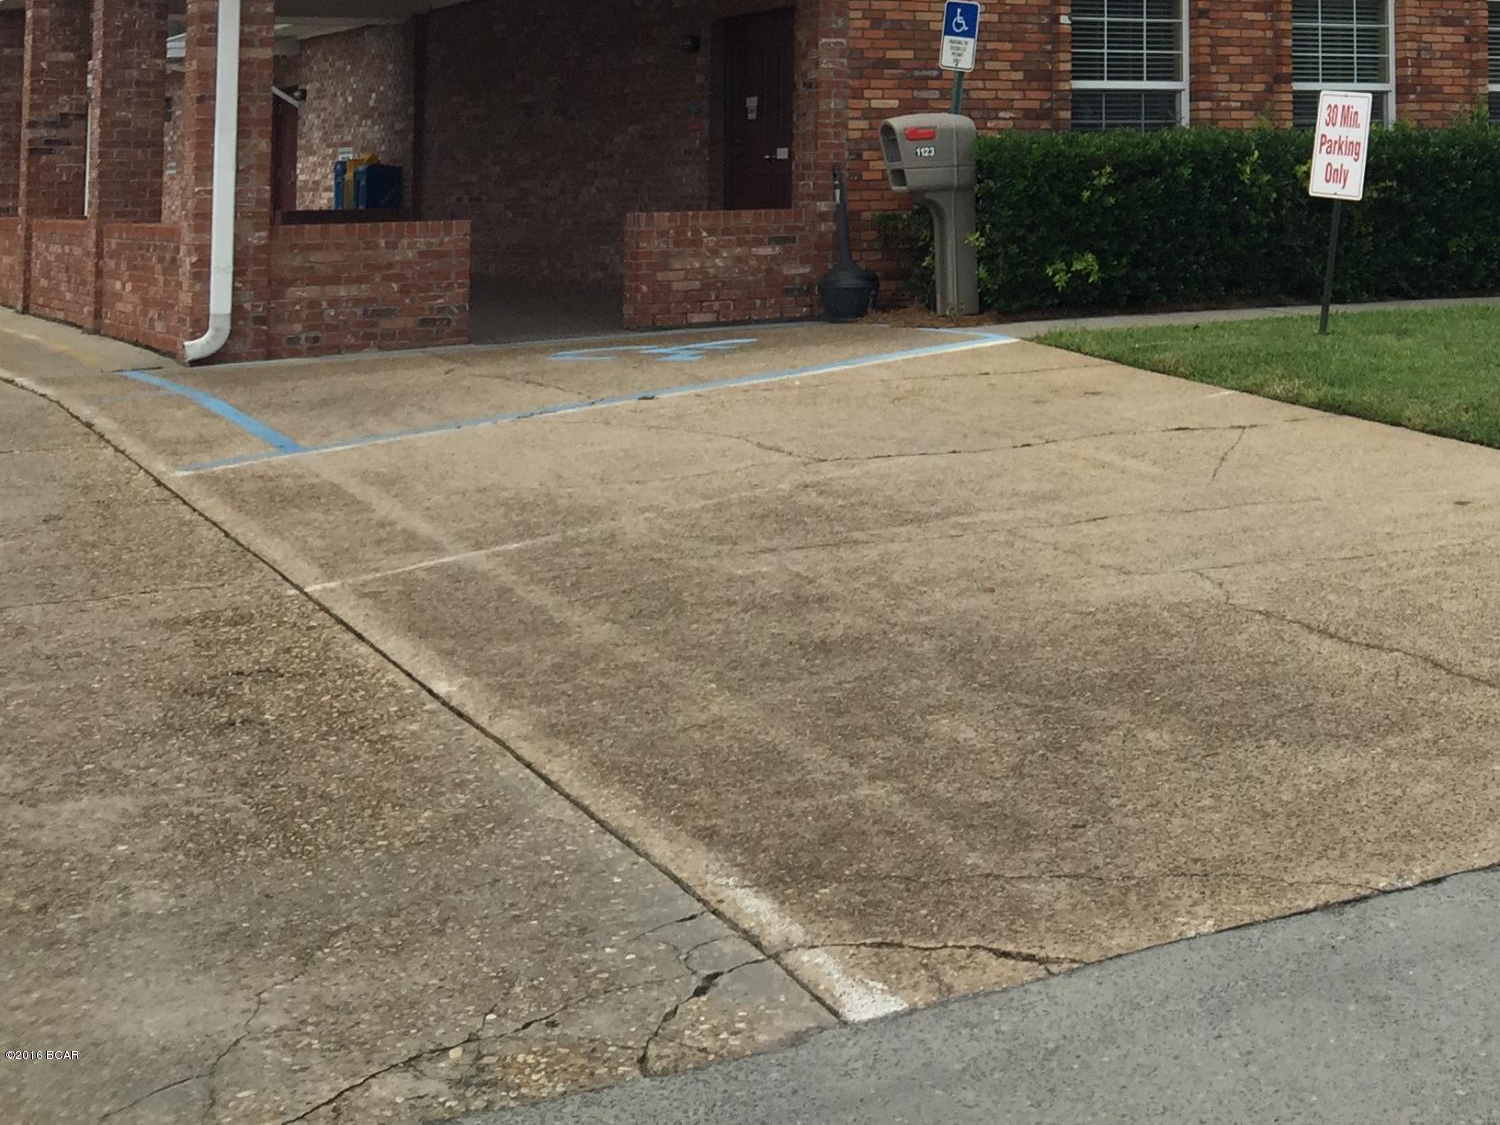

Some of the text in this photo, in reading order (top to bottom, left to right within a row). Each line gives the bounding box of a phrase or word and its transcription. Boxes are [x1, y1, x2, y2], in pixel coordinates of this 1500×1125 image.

[1325, 104, 1360, 128] 30 Min.
[915, 146, 935, 157] 1123
[1319, 134, 1361, 162] Parking
[1325, 163, 1349, 189] Only
